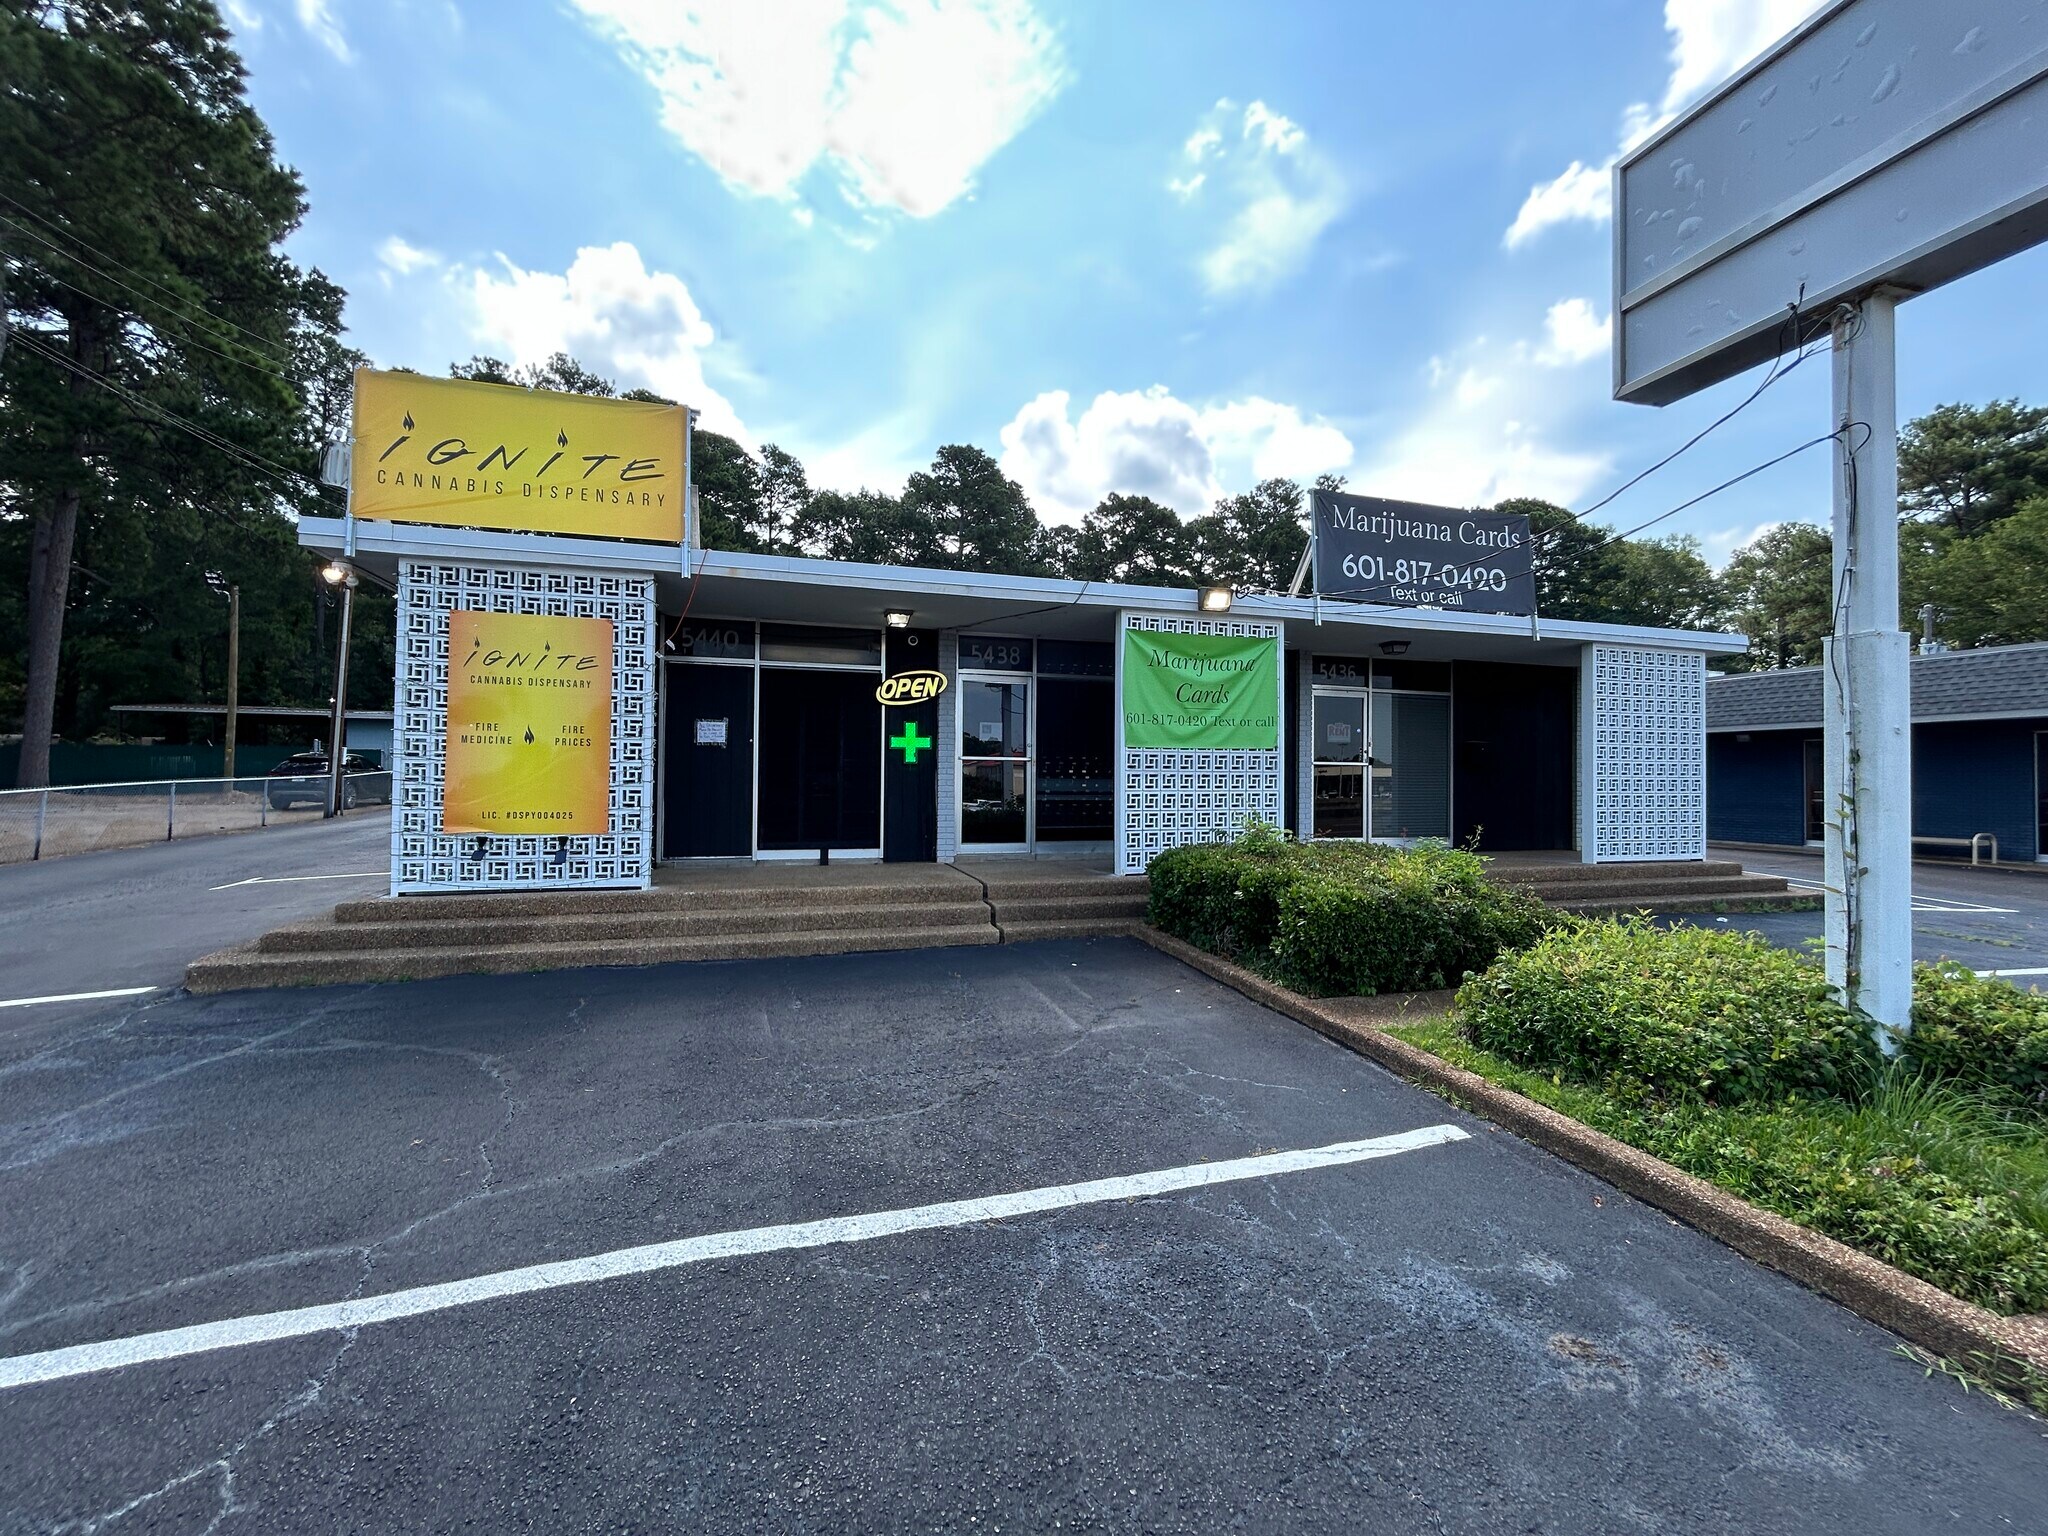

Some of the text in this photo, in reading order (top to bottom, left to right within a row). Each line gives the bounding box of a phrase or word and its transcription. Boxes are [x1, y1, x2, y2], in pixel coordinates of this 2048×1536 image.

[377, 469, 666, 507] CANNABIS DISPENSARY
[1332, 504, 1521, 549] Marijuana Cards
[1342, 553, 1508, 592] 601-817-0420
[1390, 585, 1463, 605] Text or call
[682, 627, 740, 650] 5440
[971, 644, 1021, 665] 5438
[1148, 649, 1256, 677] Marijuana
[1320, 663, 1356, 680] 5436
[470, 675, 592, 689] CANNABIS DISPENSARY
[880, 677, 941, 699] OPEN
[1176, 683, 1230, 704] Cards
[475, 722, 499, 732] FIRE
[562, 725, 585, 734] FIRE
[1126, 712, 1275, 727] 601-817-0420 Text or call
[460, 735, 512, 745] MEDICINE
[554, 737, 592, 747] PRICES
[481, 811, 574, 820] LIC. #DSPY004025
